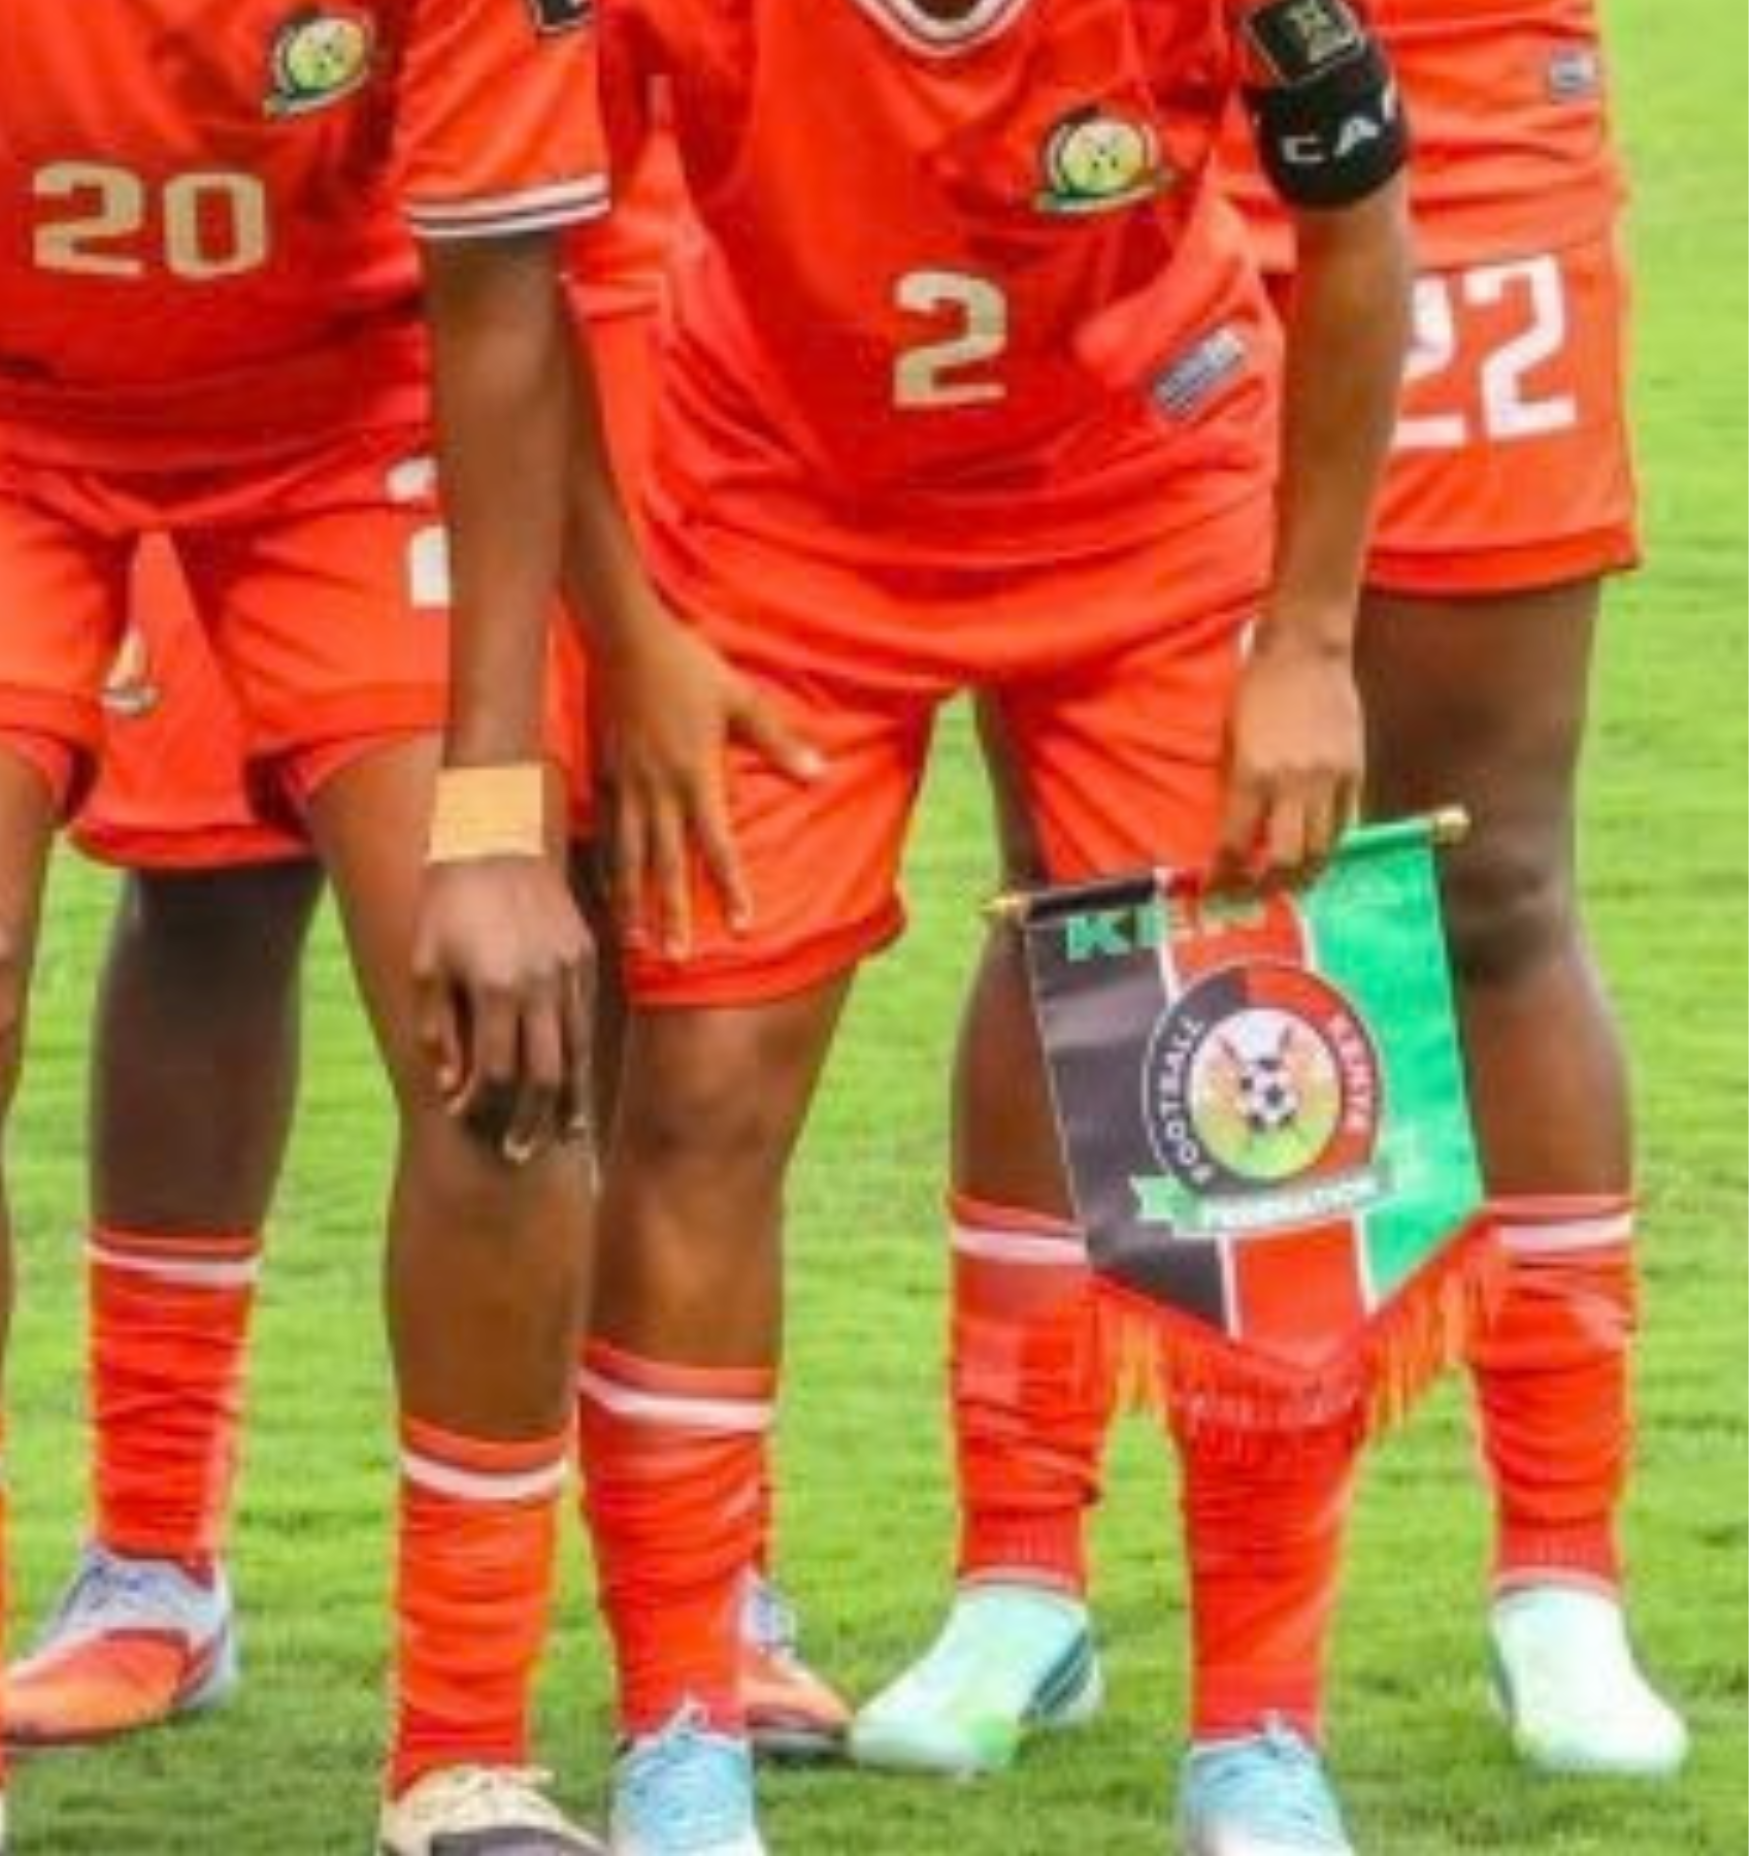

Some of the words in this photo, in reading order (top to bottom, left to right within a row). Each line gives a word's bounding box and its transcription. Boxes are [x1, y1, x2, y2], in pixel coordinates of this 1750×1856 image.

[31, 162, 268, 279] 20
[892, 270, 1008, 409] 2
[1394, 254, 1577, 450] 22
